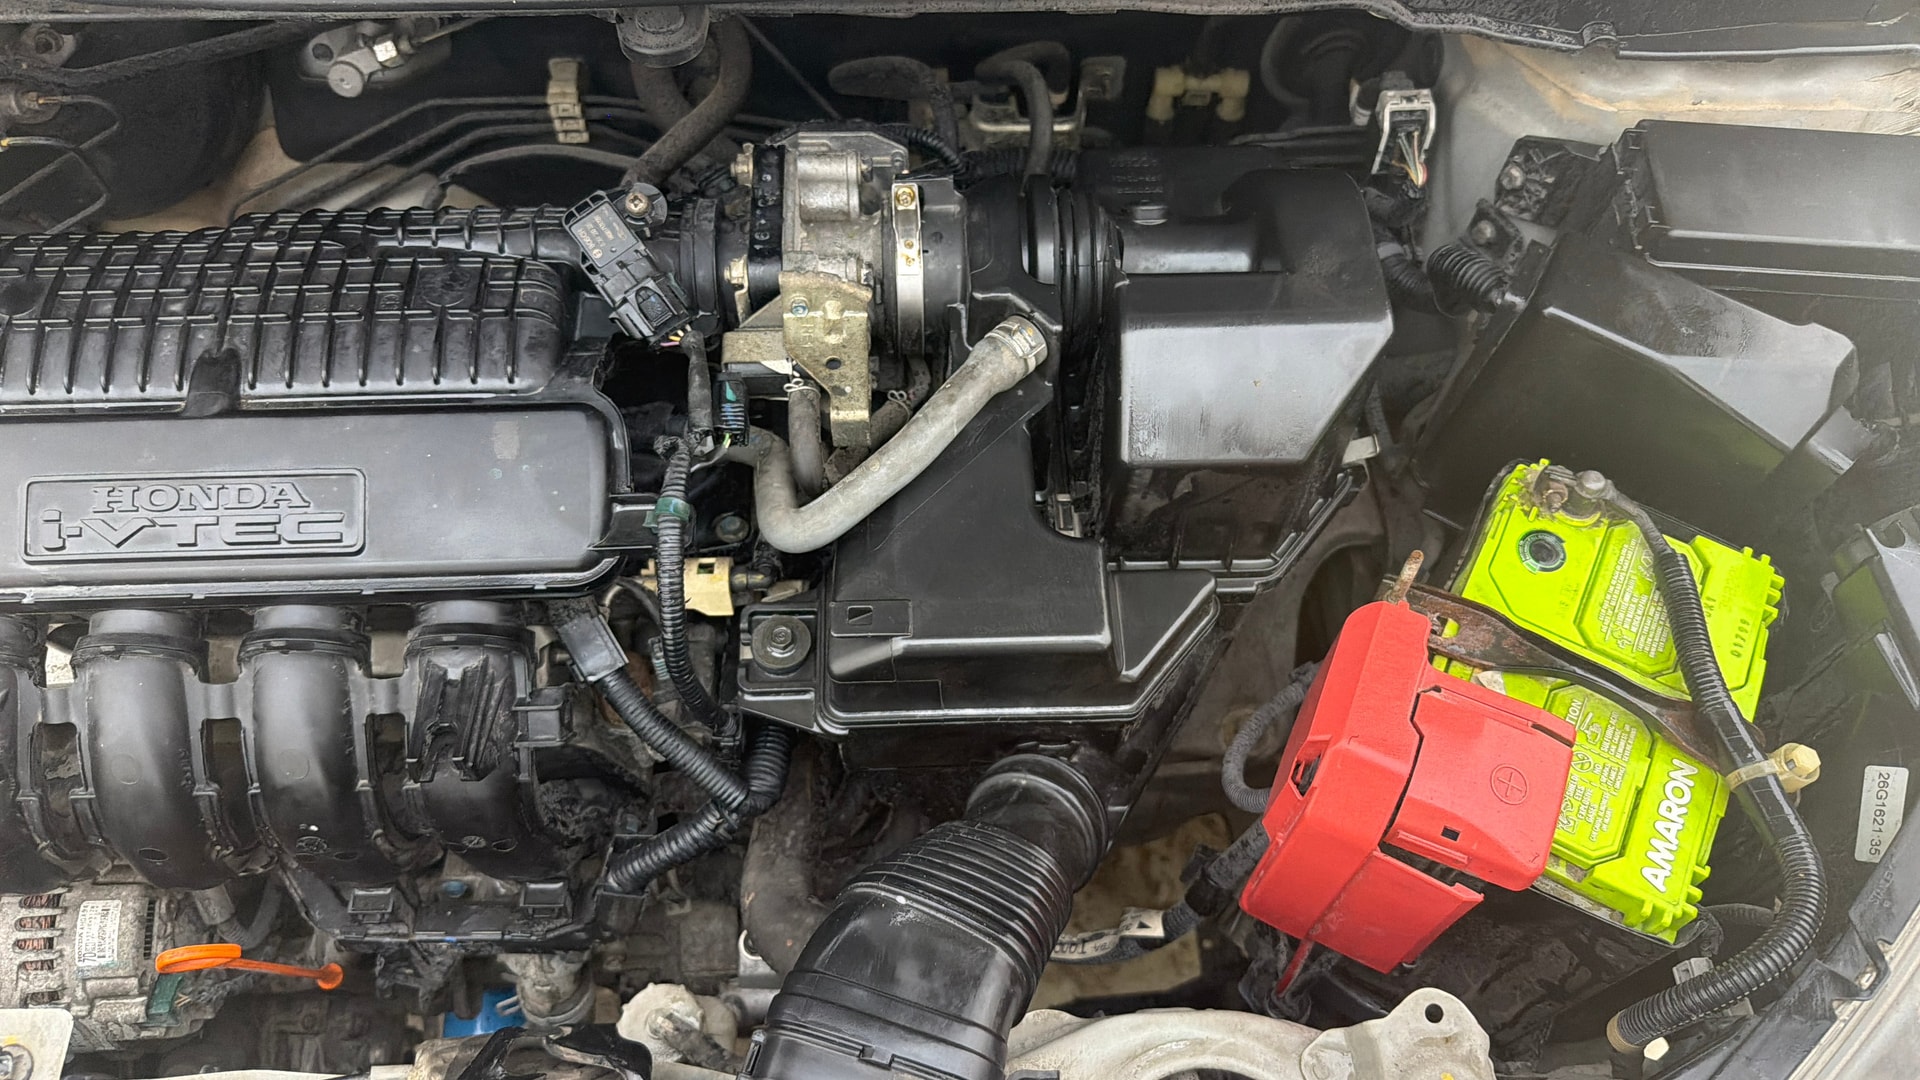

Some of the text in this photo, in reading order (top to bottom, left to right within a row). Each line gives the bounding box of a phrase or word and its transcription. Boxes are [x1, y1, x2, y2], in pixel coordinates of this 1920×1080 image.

[91, 481, 311, 514] HONDA
[42, 508, 346, 552] i-VTEC
[1565, 698, 1582, 724] TION
[1641, 759, 1698, 893] AMARON
